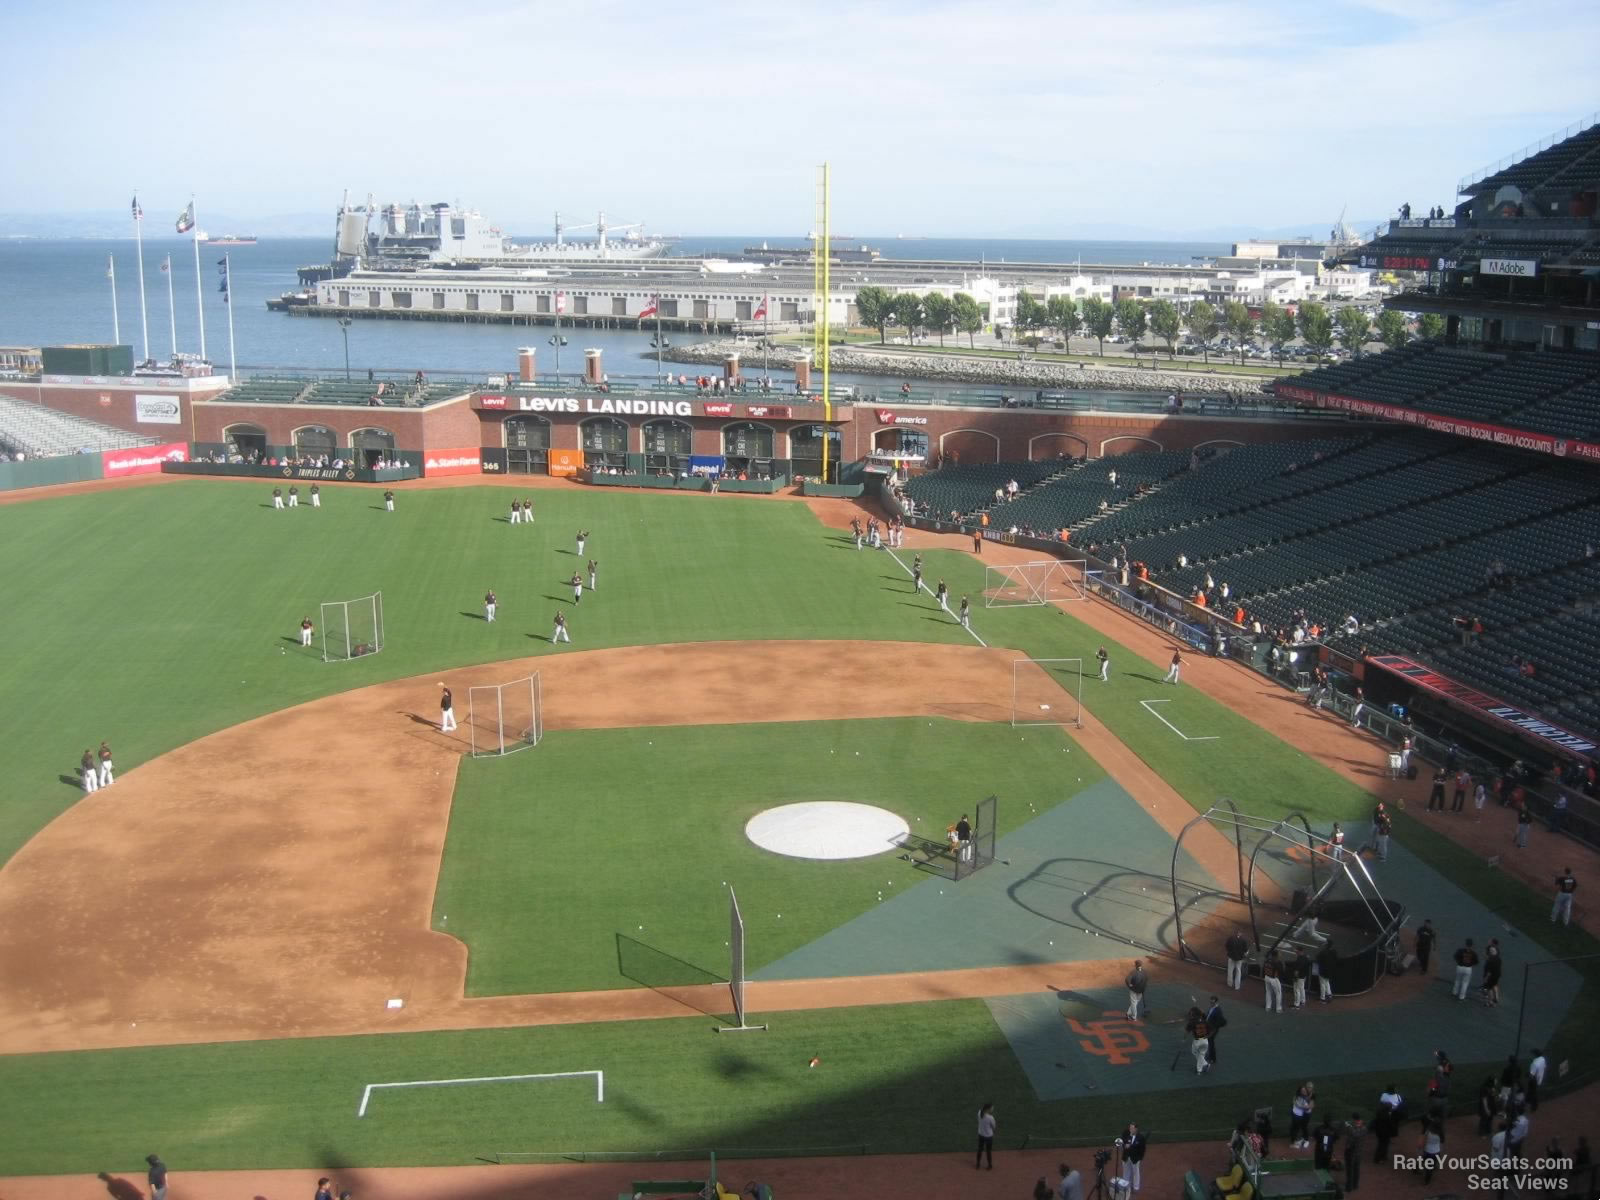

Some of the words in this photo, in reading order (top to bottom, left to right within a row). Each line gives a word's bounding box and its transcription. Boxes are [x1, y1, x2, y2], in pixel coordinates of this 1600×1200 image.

[1445, 259, 1457, 269] at&t
[1499, 261, 1525, 275] Adobe
[587, 399, 692, 416] LANDING
[706, 403, 732, 413] Levi's
[894, 416, 928, 425] america
[1426, 419, 1455, 433] CONNECT
[1455, 424, 1470, 437] WITH
[1470, 427, 1493, 441] SOCIAL
[1493, 431, 1514, 445] MEDIA
[1513, 435, 1552, 453] ACCOUNTS
[108, 458, 127, 469] Bank
[136, 455, 167, 466] America
[483, 462, 499, 470] 365
[298, 469, 320, 477] TRIPLES
[321, 470, 340, 478] ALLEY
[1507, 716, 1597, 751] WELCOME
